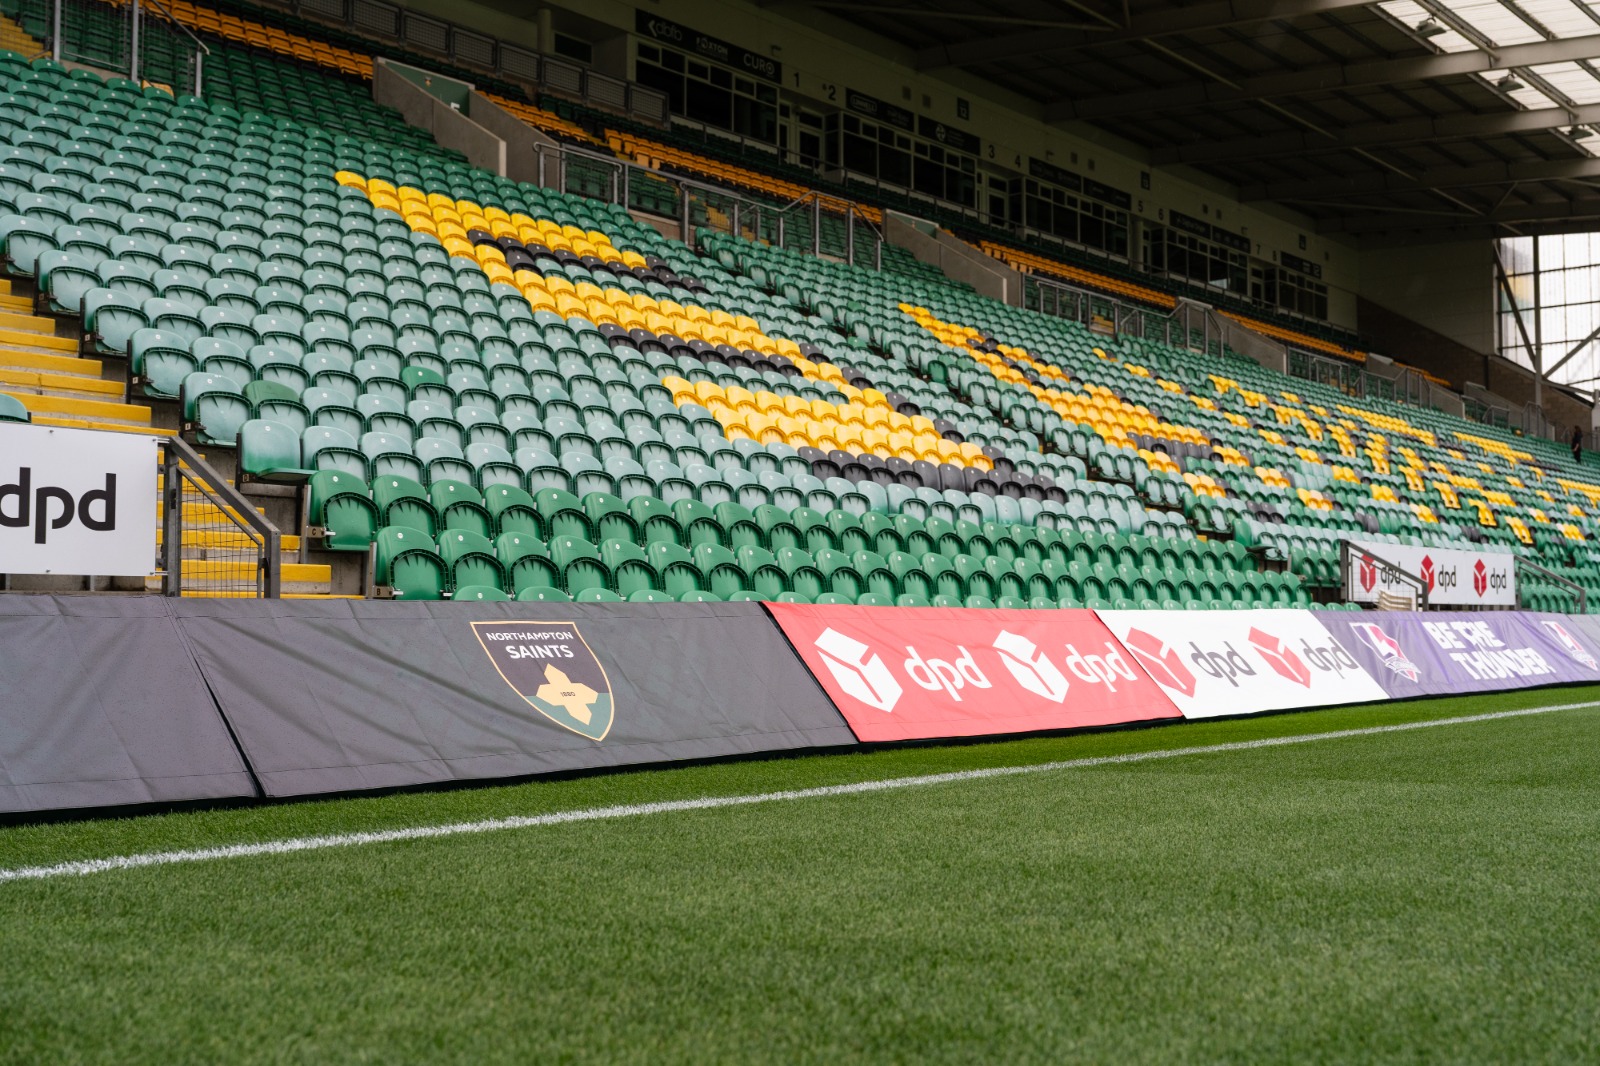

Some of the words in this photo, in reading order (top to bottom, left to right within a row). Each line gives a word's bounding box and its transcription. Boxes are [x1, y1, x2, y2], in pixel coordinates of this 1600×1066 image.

[743, 53, 776, 76] CURO
[793, 72, 800, 88] 1
[828, 84, 836, 101] 2
[988, 144, 995, 158] 3
[1014, 154, 1021, 168] 4
[1138, 200, 1144, 212] 5
[1158, 208, 1164, 220] 6
[1256, 244, 1262, 255] 7
[0, 466, 117, 545] dpd
[1380, 561, 1401, 590] dpd
[1438, 564, 1457, 593] dpd
[1490, 568, 1507, 594] dpd
[486, 631, 574, 641] NORTHAMPTON
[1421, 620, 1467, 649] BE
[1452, 620, 1505, 648] THE
[505, 644, 574, 659] SAINTS
[1298, 637, 1358, 681] dpd
[904, 645, 993, 702] dpd
[1066, 642, 1138, 693] dpd
[1188, 640, 1258, 688] dpd
[1450, 647, 1557, 681] THUNDER
